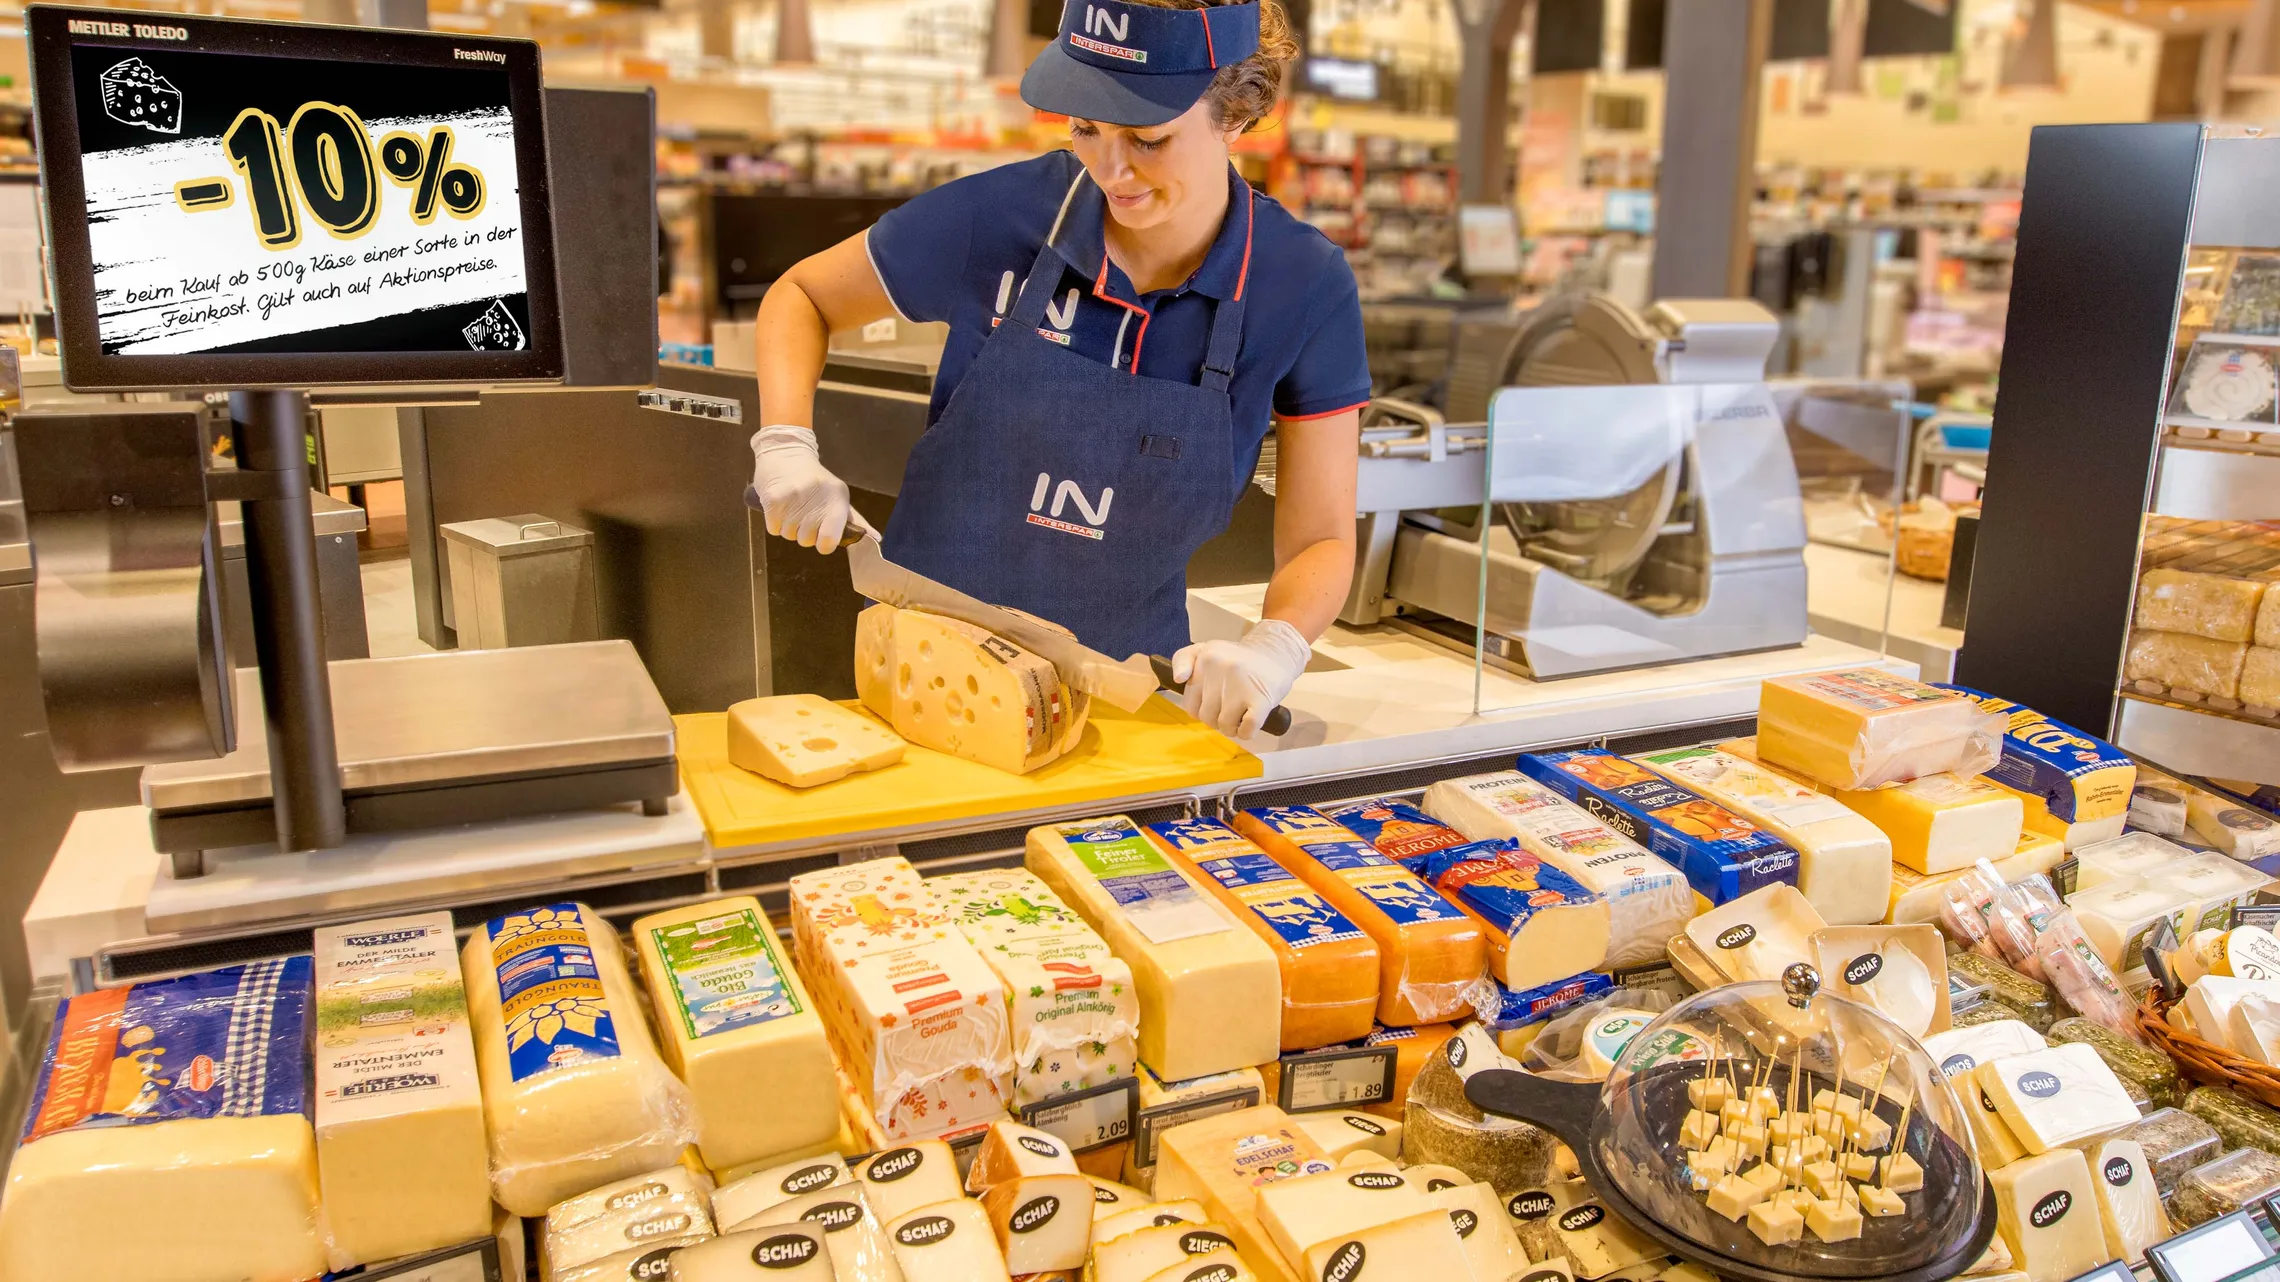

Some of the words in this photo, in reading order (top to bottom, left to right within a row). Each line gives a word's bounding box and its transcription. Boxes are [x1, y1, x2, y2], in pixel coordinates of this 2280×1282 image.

[68, 19, 131, 37] METTLER
[133, 23, 189, 41] TOLEDO
[1085, 4, 1129, 41] IN
[453, 47, 507, 65] FreshWay
[1075, 36, 1134, 58] INTERSPAR
[174, 100, 488, 251] -10%
[126, 284, 174, 304] beim
[180, 274, 221, 296] Kauf
[229, 269, 249, 287] ab
[256, 260, 306, 284] 500g
[310, 253, 356, 273] Käse
[363, 245, 409, 264] einer
[413, 234, 458, 255] Sorte
[463, 230, 480, 246] in
[486, 226, 517, 243] der
[161, 296, 250, 327] Feinkost.
[257, 288, 295, 320] Gilt
[302, 282, 341, 301] auch
[347, 276, 372, 295] auf
[379, 257, 498, 289] Aktionspreise.
[1030, 472, 1114, 526] IN
[1033, 516, 1094, 537] INTERSPAR
[1468, 776, 1527, 792] PROTEIN
[1618, 784, 1671, 798] Raclette
[1585, 797, 1637, 838] Raclette
[1094, 848, 1137, 858] Feiner
[1388, 832, 1465, 859] JEROME
[1096, 854, 1145, 865] Tiroler
[1584, 851, 1646, 868] PROTEIN
[1748, 855, 1794, 877] Raclette
[497, 934, 587, 960] TRAUNGOLD
[1719, 927, 1753, 947] SCHAF
[357, 951, 379, 959] DER
[382, 947, 417, 955] MILDE
[700, 970, 754, 988] Gouda
[1848, 956, 1879, 982] SCHAF
[505, 982, 601, 1012] TRAUNGOLD
[711, 980, 747, 994] Bio-
[1055, 990, 1100, 1004] Premium
[1534, 986, 1580, 1012] JEROME
[911, 1006, 963, 1031] Premium
[1035, 1005, 1075, 1022] Original
[920, 1020, 957, 1040] Gouda
[1655, 1032, 1679, 1048] Sale
[333, 1049, 443, 1069] EMMENTALER
[1450, 1037, 1466, 1065] SCHAF
[353, 1064, 392, 1073] MILDE
[400, 1060, 422, 1068] DER
[1352, 1083, 1382, 1098] 1.89
[2022, 1077, 2055, 1092] SCHAF
[1097, 1120, 1127, 1140] 2.09
[1350, 1117, 1380, 1133] ZIEGE
[1021, 1138, 1056, 1155] SCHAF
[1236, 1144, 1295, 1166] EDELSCHAF
[872, 1150, 918, 1179] SCHAF
[2107, 1164, 2130, 1181] SCHAF
[786, 1167, 833, 1192] SCHAF
[1354, 1174, 1398, 1186] SCHAF
[612, 1186, 662, 1209] SCHAF
[1513, 1198, 1550, 1215] SCHAF
[1014, 1199, 1056, 1230] SCHAF
[1563, 1208, 1600, 1230] SCHAF
[2033, 1194, 2069, 1224] SCHAF
[632, 1216, 684, 1239] SCHAF
[901, 1220, 949, 1242] SCHAF
[758, 1241, 813, 1264] SCHAF
[1326, 1244, 1362, 1282] SCHAF
[638, 1258, 670, 1278] SCH
